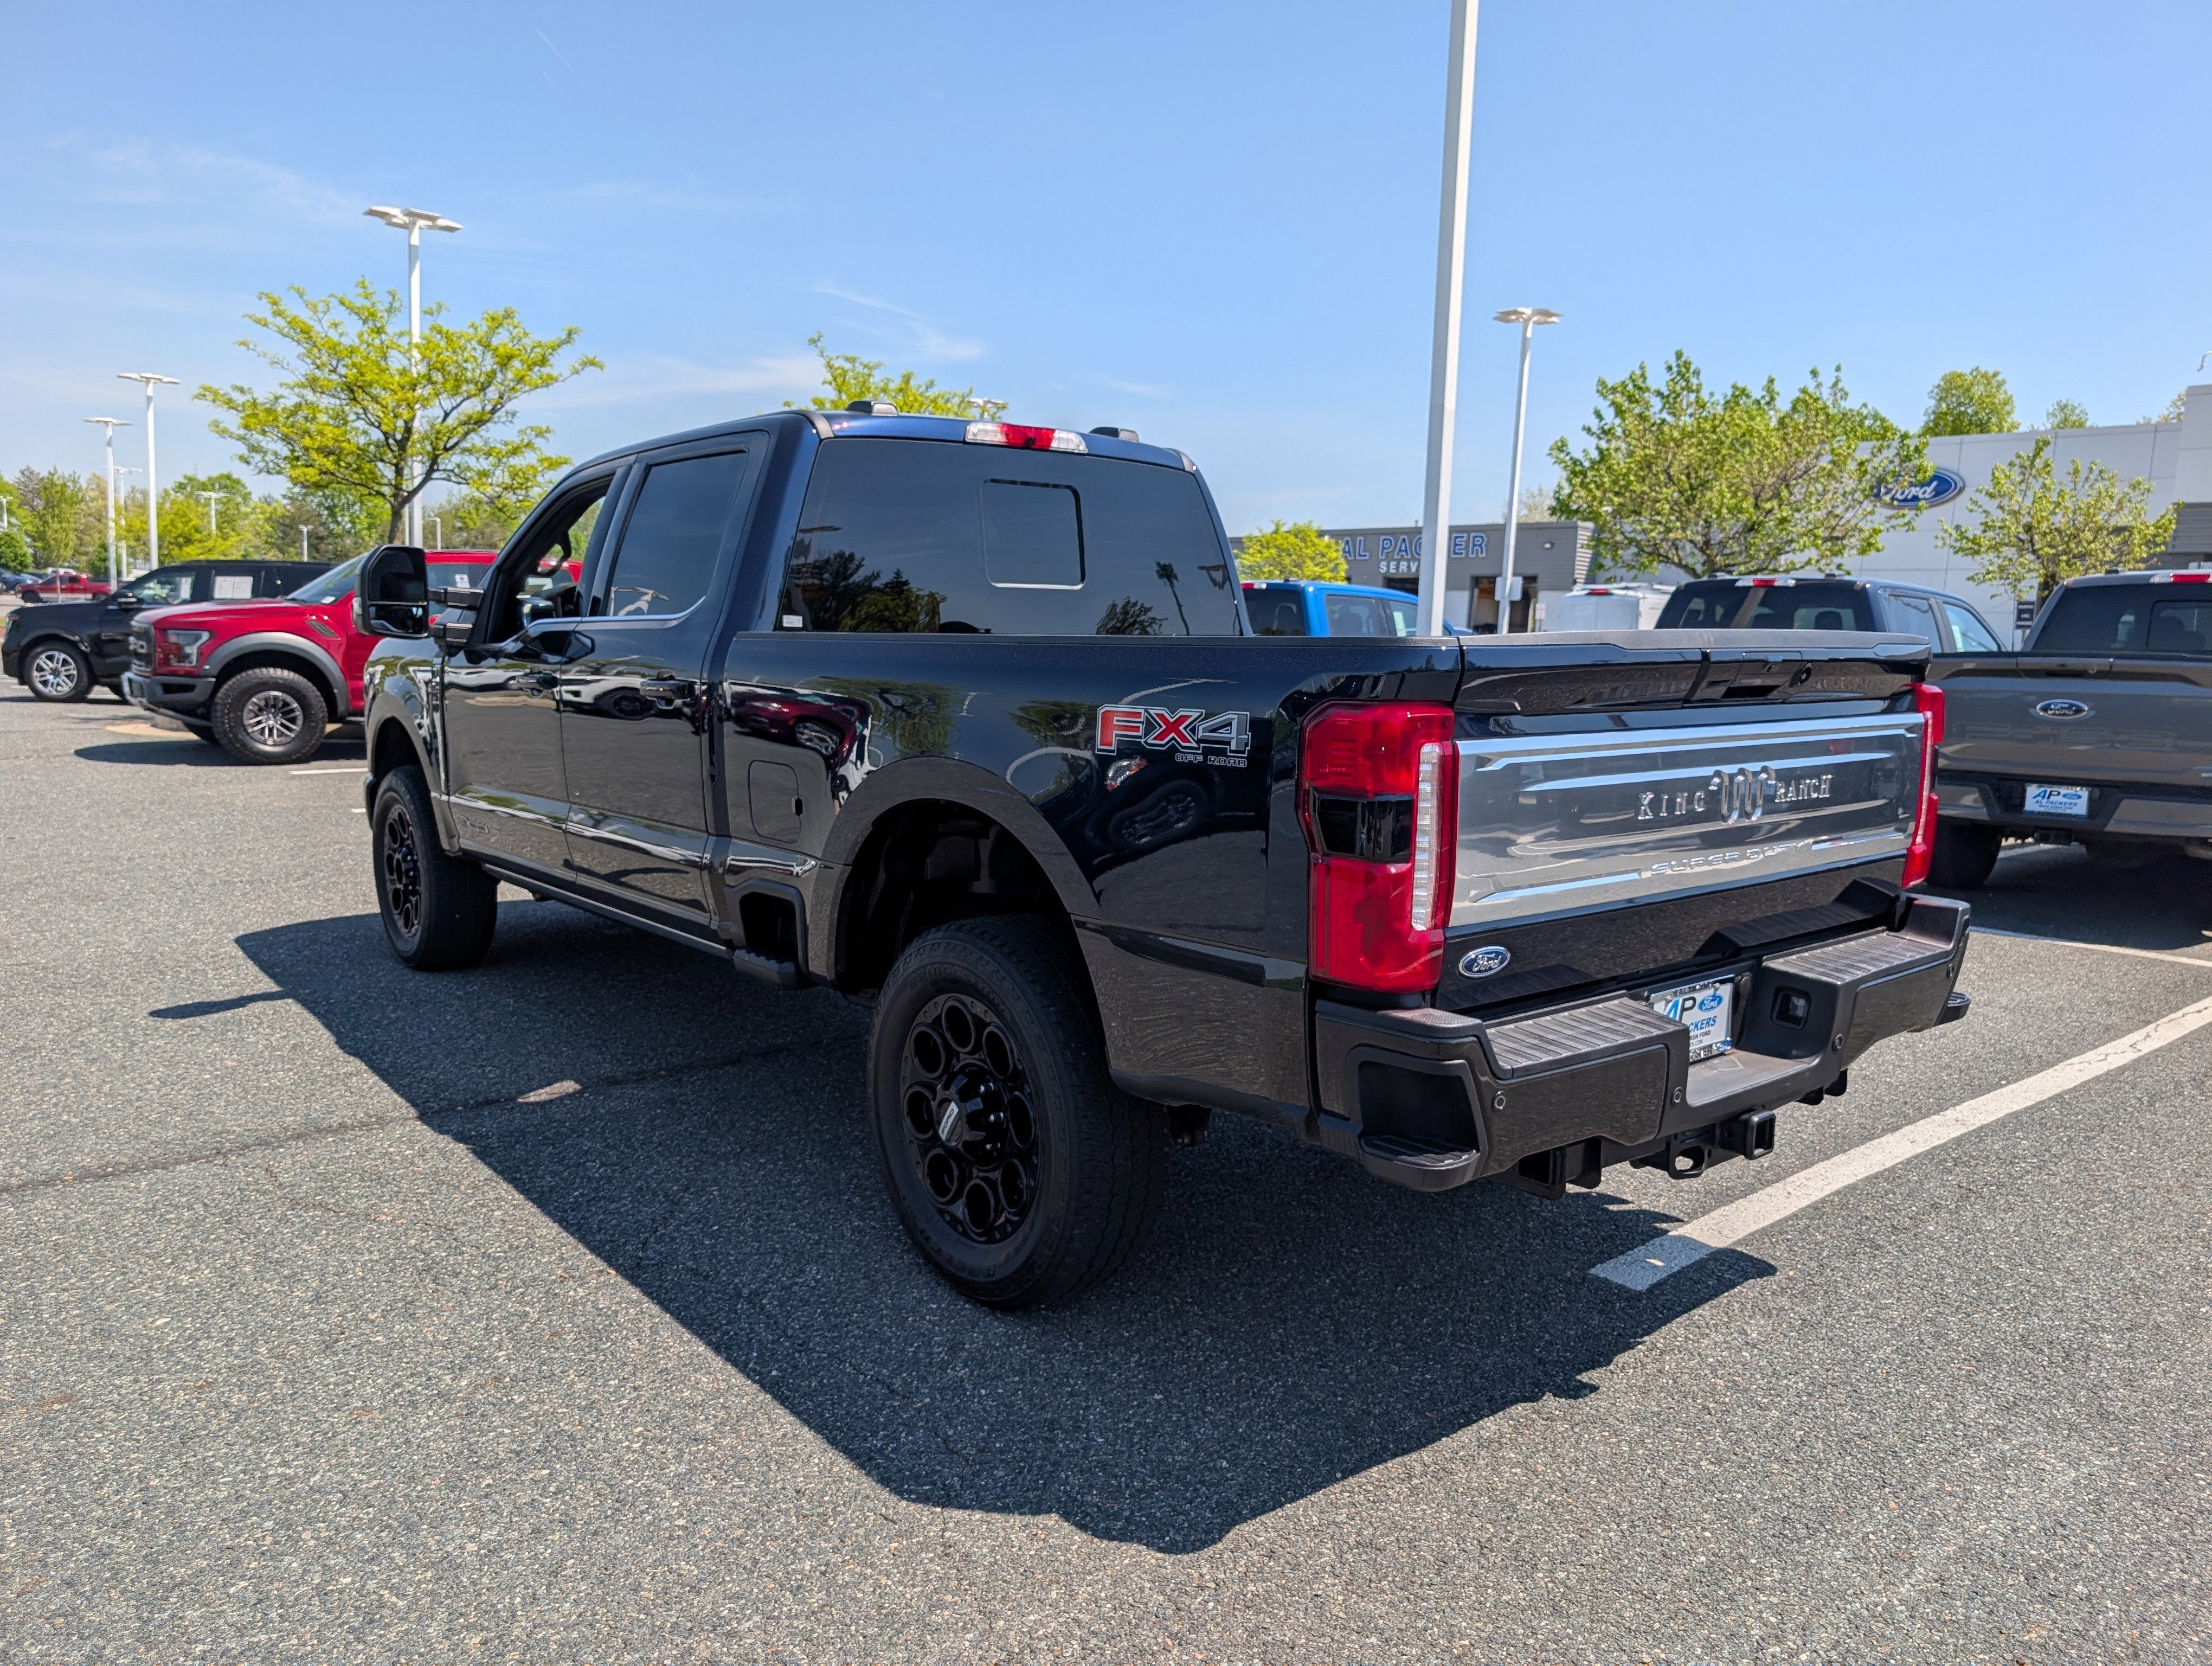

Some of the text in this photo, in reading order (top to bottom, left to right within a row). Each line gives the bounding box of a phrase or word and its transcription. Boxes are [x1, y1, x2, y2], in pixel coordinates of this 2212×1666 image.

[1342, 533, 1487, 560] AL PACER
[1379, 561, 1420, 573] SERV
[1095, 704, 1251, 757] FX4
[1175, 753, 1248, 767] OFF ROAD
[1637, 790, 1706, 820] KING
[1774, 774, 1832, 803] RANCH
[1651, 841, 1806, 875] SUPER DUTY
[1472, 953, 1502, 972] Ford
[1701, 996, 1720, 1010] Ford
[1689, 1015, 1718, 1033] CKERS
[1699, 1029, 1711, 1038] FORD
